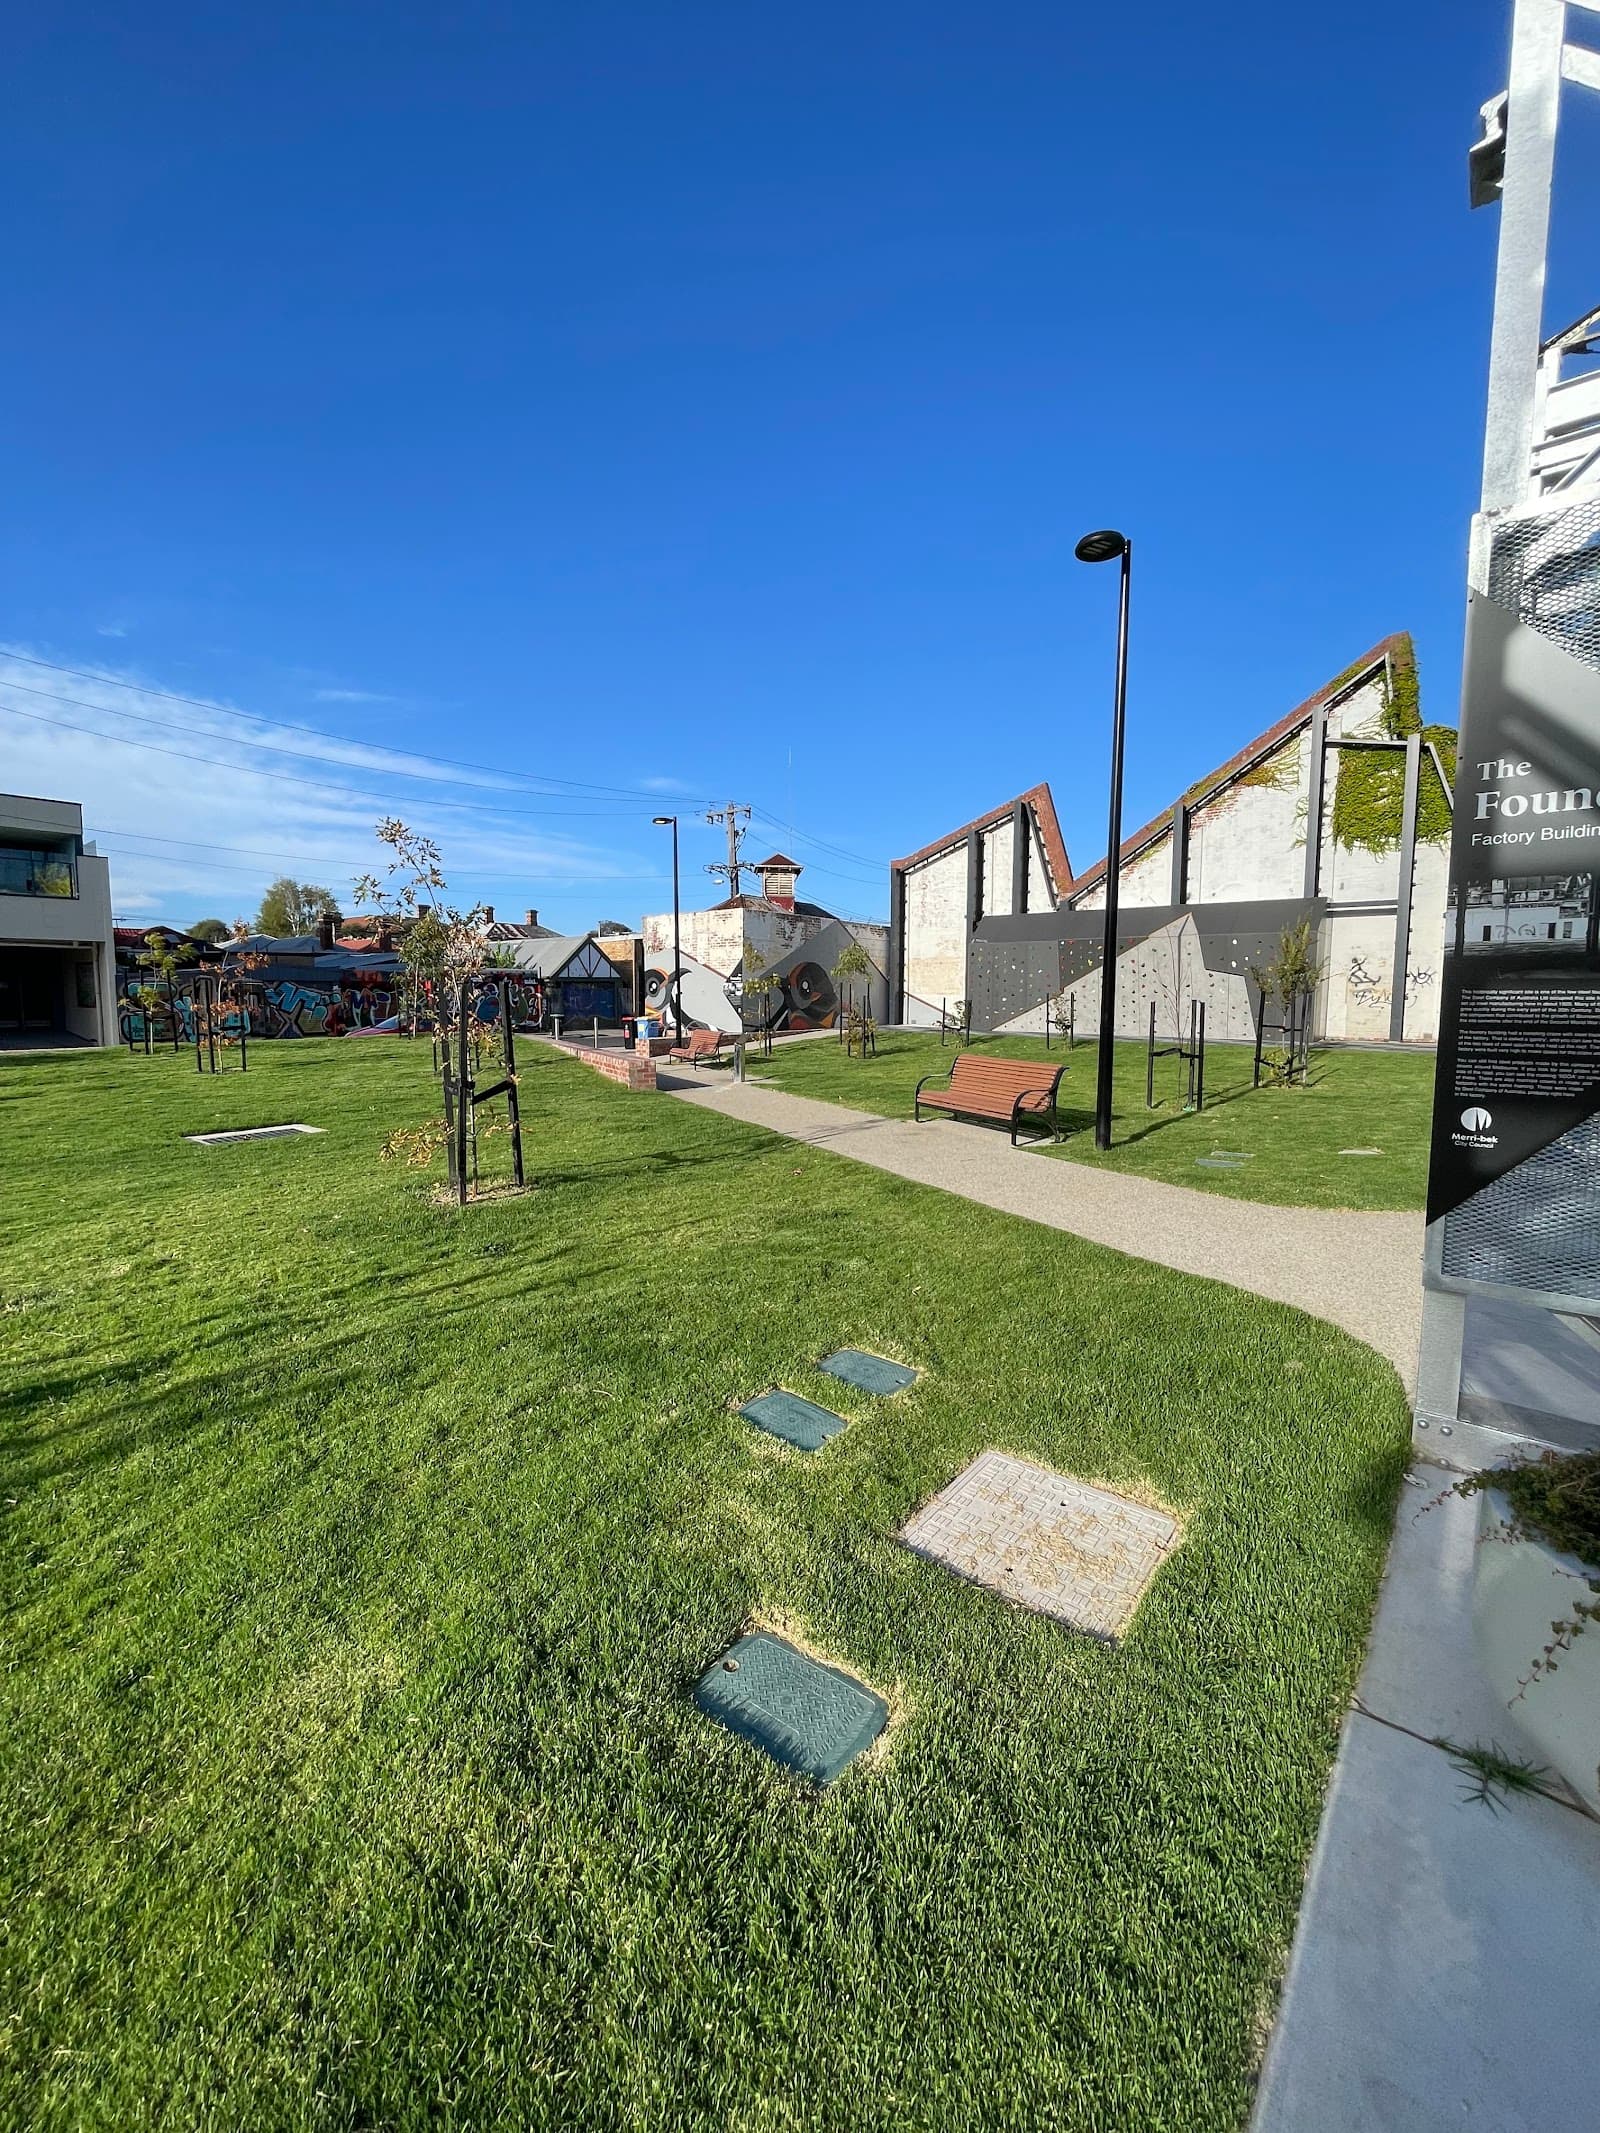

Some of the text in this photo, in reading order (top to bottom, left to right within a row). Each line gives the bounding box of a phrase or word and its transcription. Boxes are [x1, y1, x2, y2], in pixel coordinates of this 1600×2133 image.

[1477, 758, 1532, 781] The
[1471, 831, 1535, 847] Factory
[1451, 1133, 1499, 1143] Merri-bek
